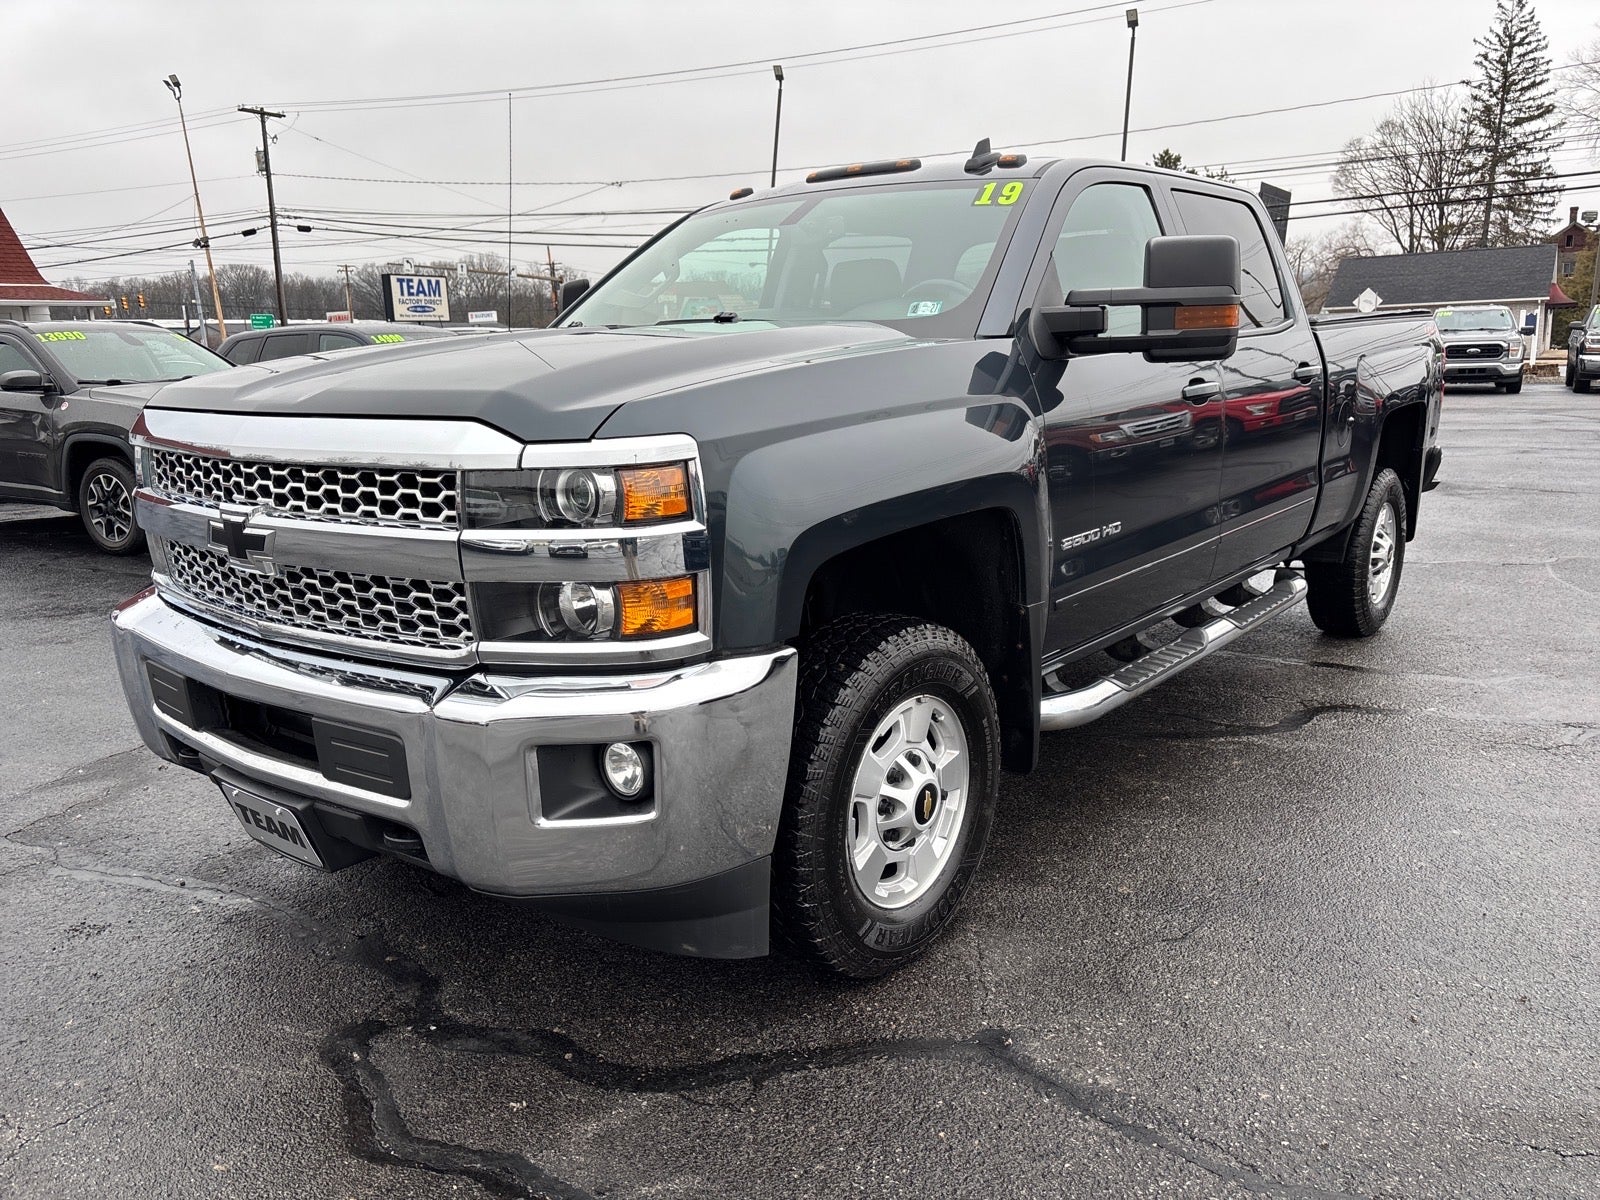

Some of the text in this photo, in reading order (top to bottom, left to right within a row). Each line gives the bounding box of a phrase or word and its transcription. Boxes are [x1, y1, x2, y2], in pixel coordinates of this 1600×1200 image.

[974, 181, 1024, 205] 19
[396, 277, 441, 297] TEAM
[423, 298, 443, 306] DIRECT
[35, 330, 87, 343] 13990
[370, 333, 405, 344] 14990
[1060, 521, 1122, 551] 2500 HD
[234, 801, 308, 850] TEAM
